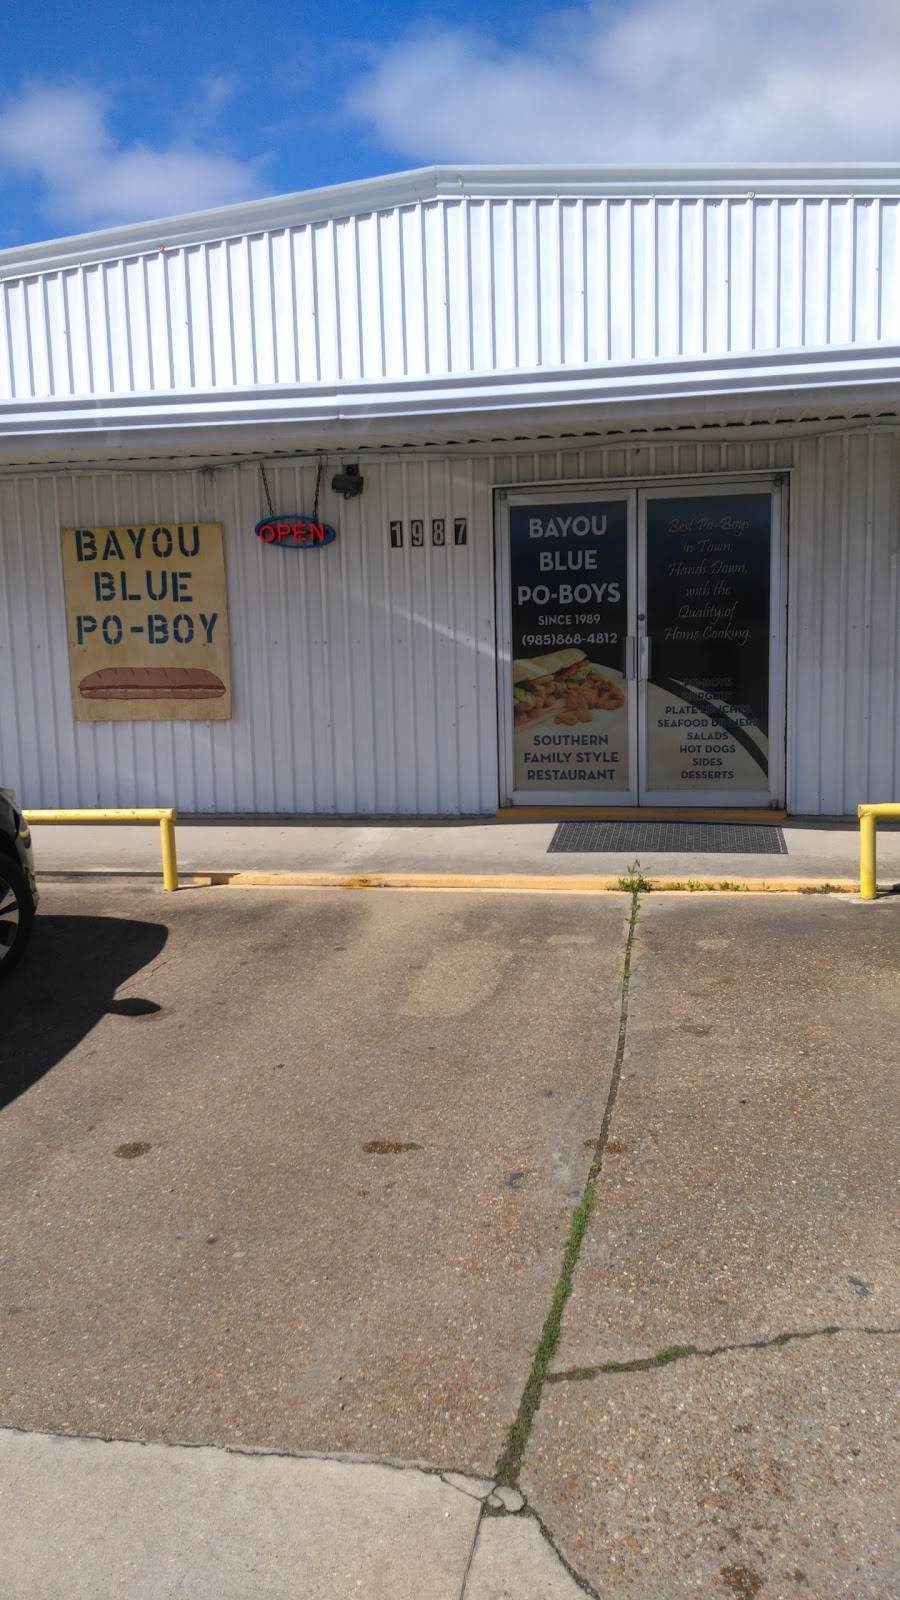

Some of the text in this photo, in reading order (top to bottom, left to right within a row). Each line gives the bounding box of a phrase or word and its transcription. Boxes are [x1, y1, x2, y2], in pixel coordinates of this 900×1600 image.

[258, 522, 327, 544] OPEN
[390, 518, 467, 548] 1987
[529, 515, 607, 538] BAYOU
[75, 526, 200, 562] BAYOU
[539, 550, 598, 572] BLUE
[668, 558, 706, 576] Hands
[94, 570, 193, 602] BLUE
[518, 582, 621, 605] PO-BOYS
[686, 580, 731, 597] with the
[538, 614, 600, 626] SINCE 1989
[679, 601, 738, 625] Quality of
[76, 613, 218, 645] PO-BOY
[664, 625, 699, 641] Home
[522, 633, 618, 646] (985)868-4812
[665, 705, 698, 714] PLATE
[657, 719, 709, 728] SEAFOOD
[533, 734, 609, 746] SOUTHERN
[688, 731, 729, 740] SALADS
[680, 744, 736, 753] HOT DOGS
[524, 752, 619, 763] FAMILY STYLE
[692, 758, 723, 766] SIDES
[528, 769, 616, 780] RESTAURANT
[681, 770, 734, 779] DESSERTS
